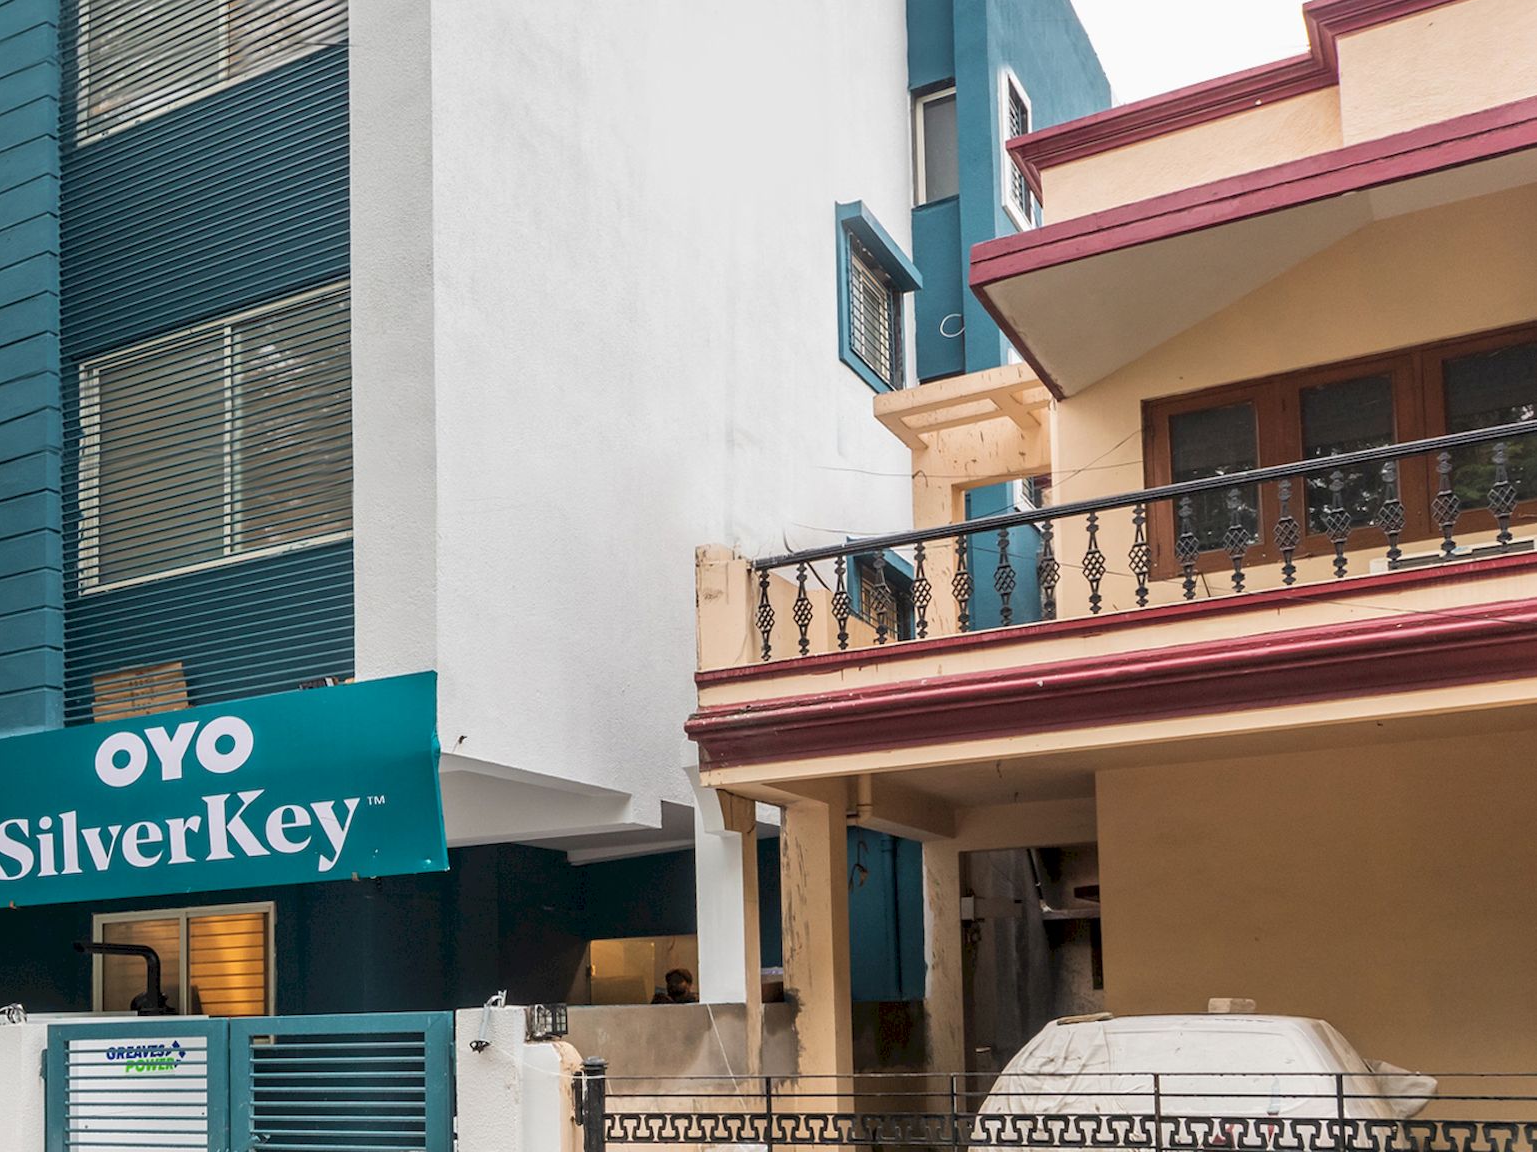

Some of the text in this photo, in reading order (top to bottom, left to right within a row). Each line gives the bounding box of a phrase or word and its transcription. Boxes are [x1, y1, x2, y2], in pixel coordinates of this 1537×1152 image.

[94, 715, 254, 788] OYO
[106, 1044, 165, 1060] GREAVES
[125, 1057, 175, 1072] POWER
